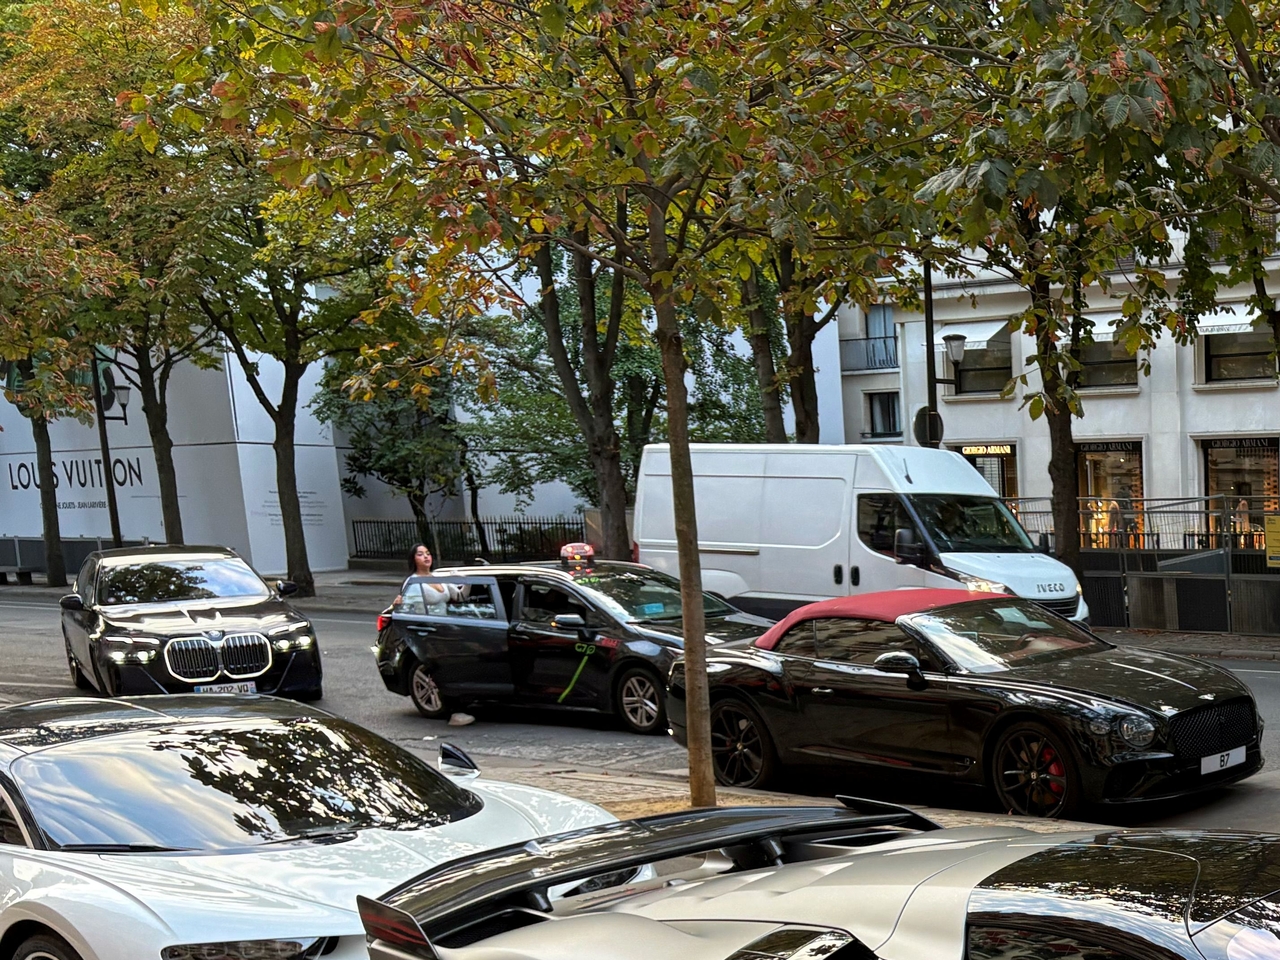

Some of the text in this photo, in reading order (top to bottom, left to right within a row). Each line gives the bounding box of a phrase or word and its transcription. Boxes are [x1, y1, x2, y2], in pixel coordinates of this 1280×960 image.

[1080, 441, 1133, 451] GIORGIO ARMANI
[1211, 438, 1269, 448] GIORGIO ARMANI
[962, 445, 1011, 455] GIORGIO ARMANI
[9, 457, 143, 490] LOUS VUITON
[1036, 582, 1065, 593] IVECO
[1220, 753, 1230, 768] B7
